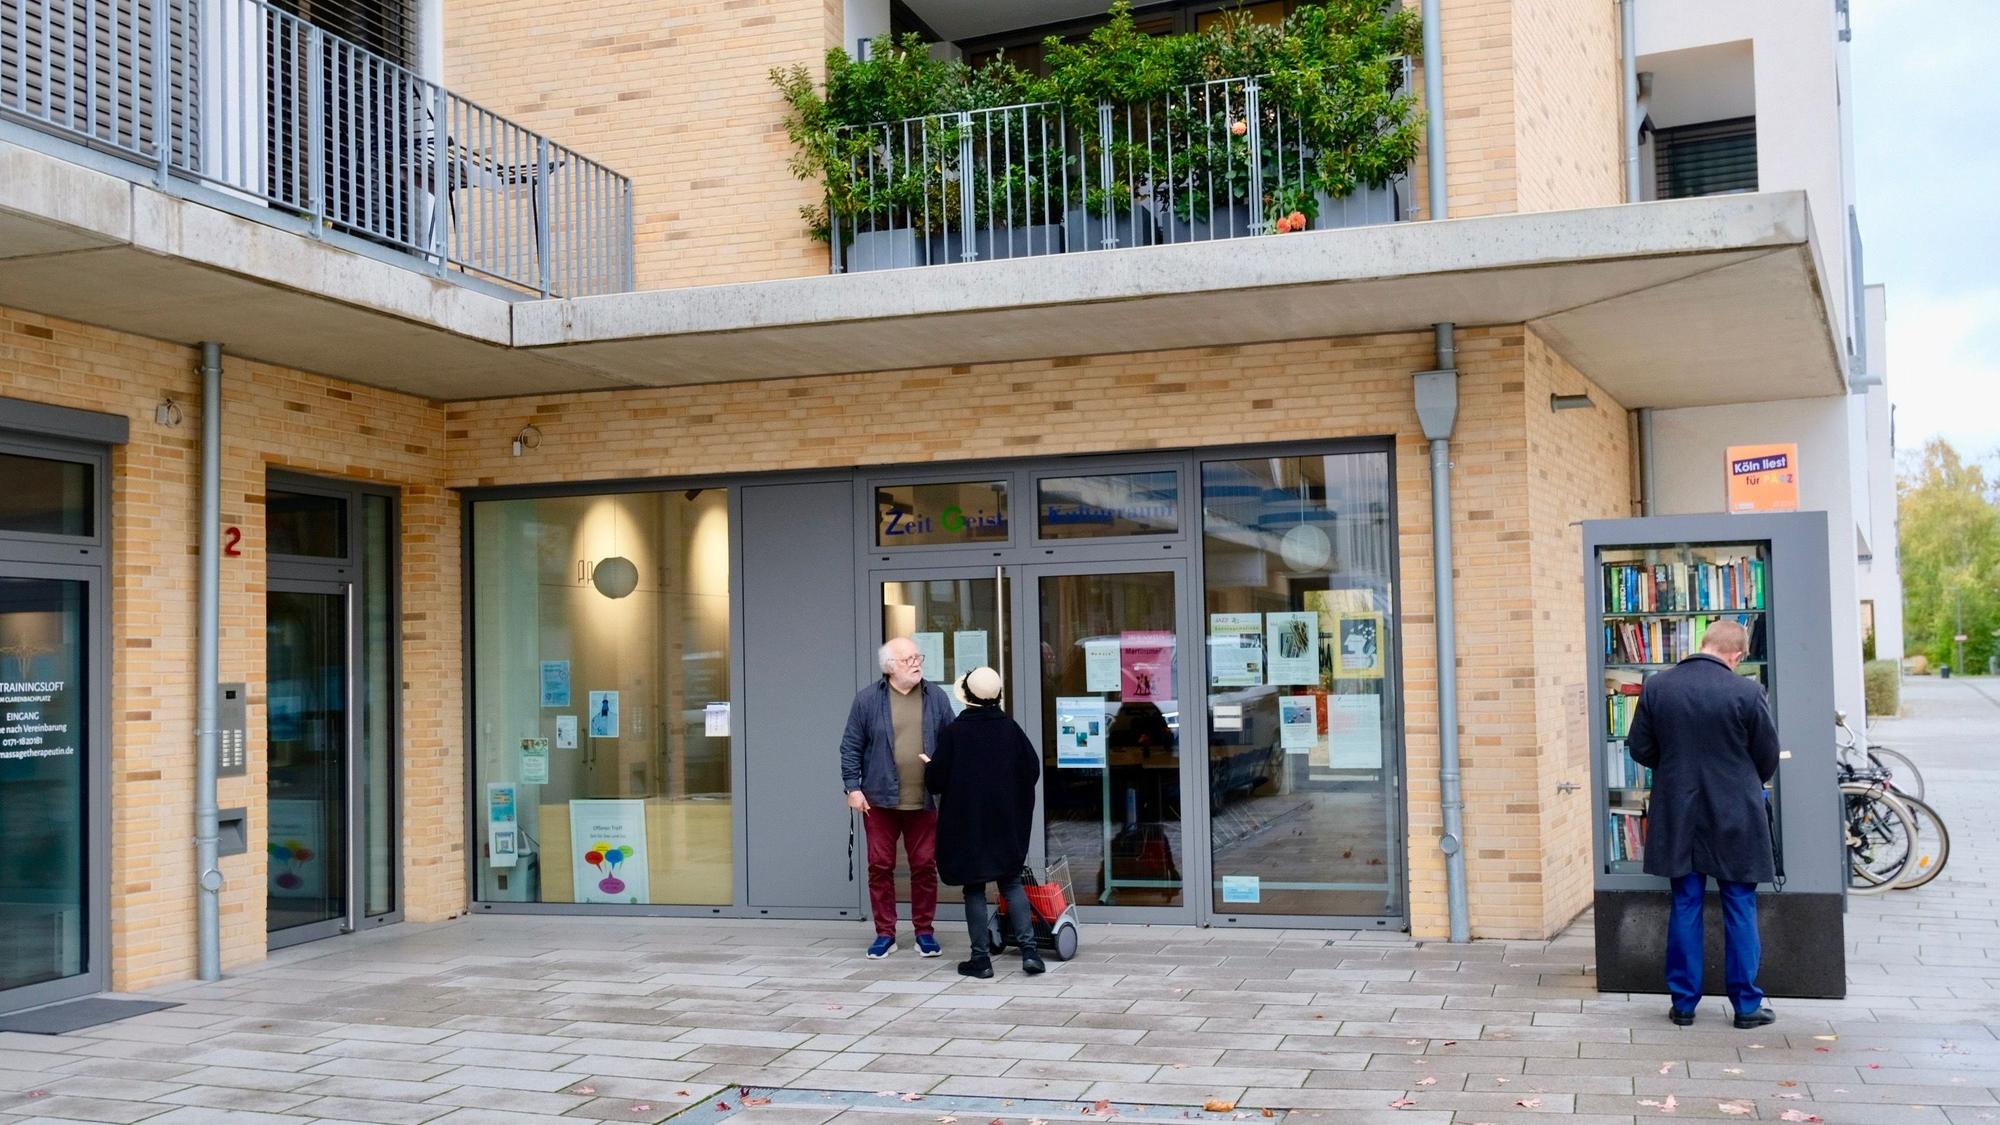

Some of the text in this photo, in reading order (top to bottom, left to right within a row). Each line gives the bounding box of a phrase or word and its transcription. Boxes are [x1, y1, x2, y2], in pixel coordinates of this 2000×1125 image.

[1734, 457, 1786, 474] Köln liest
[1746, 475, 1760, 486] für
[885, 511, 933, 535] Zeit
[224, 527, 241, 557] 2
[6, 712, 40, 721] EINGANG
[6, 724, 22, 734] nach
[23, 723, 67, 733] Vereinbarung
